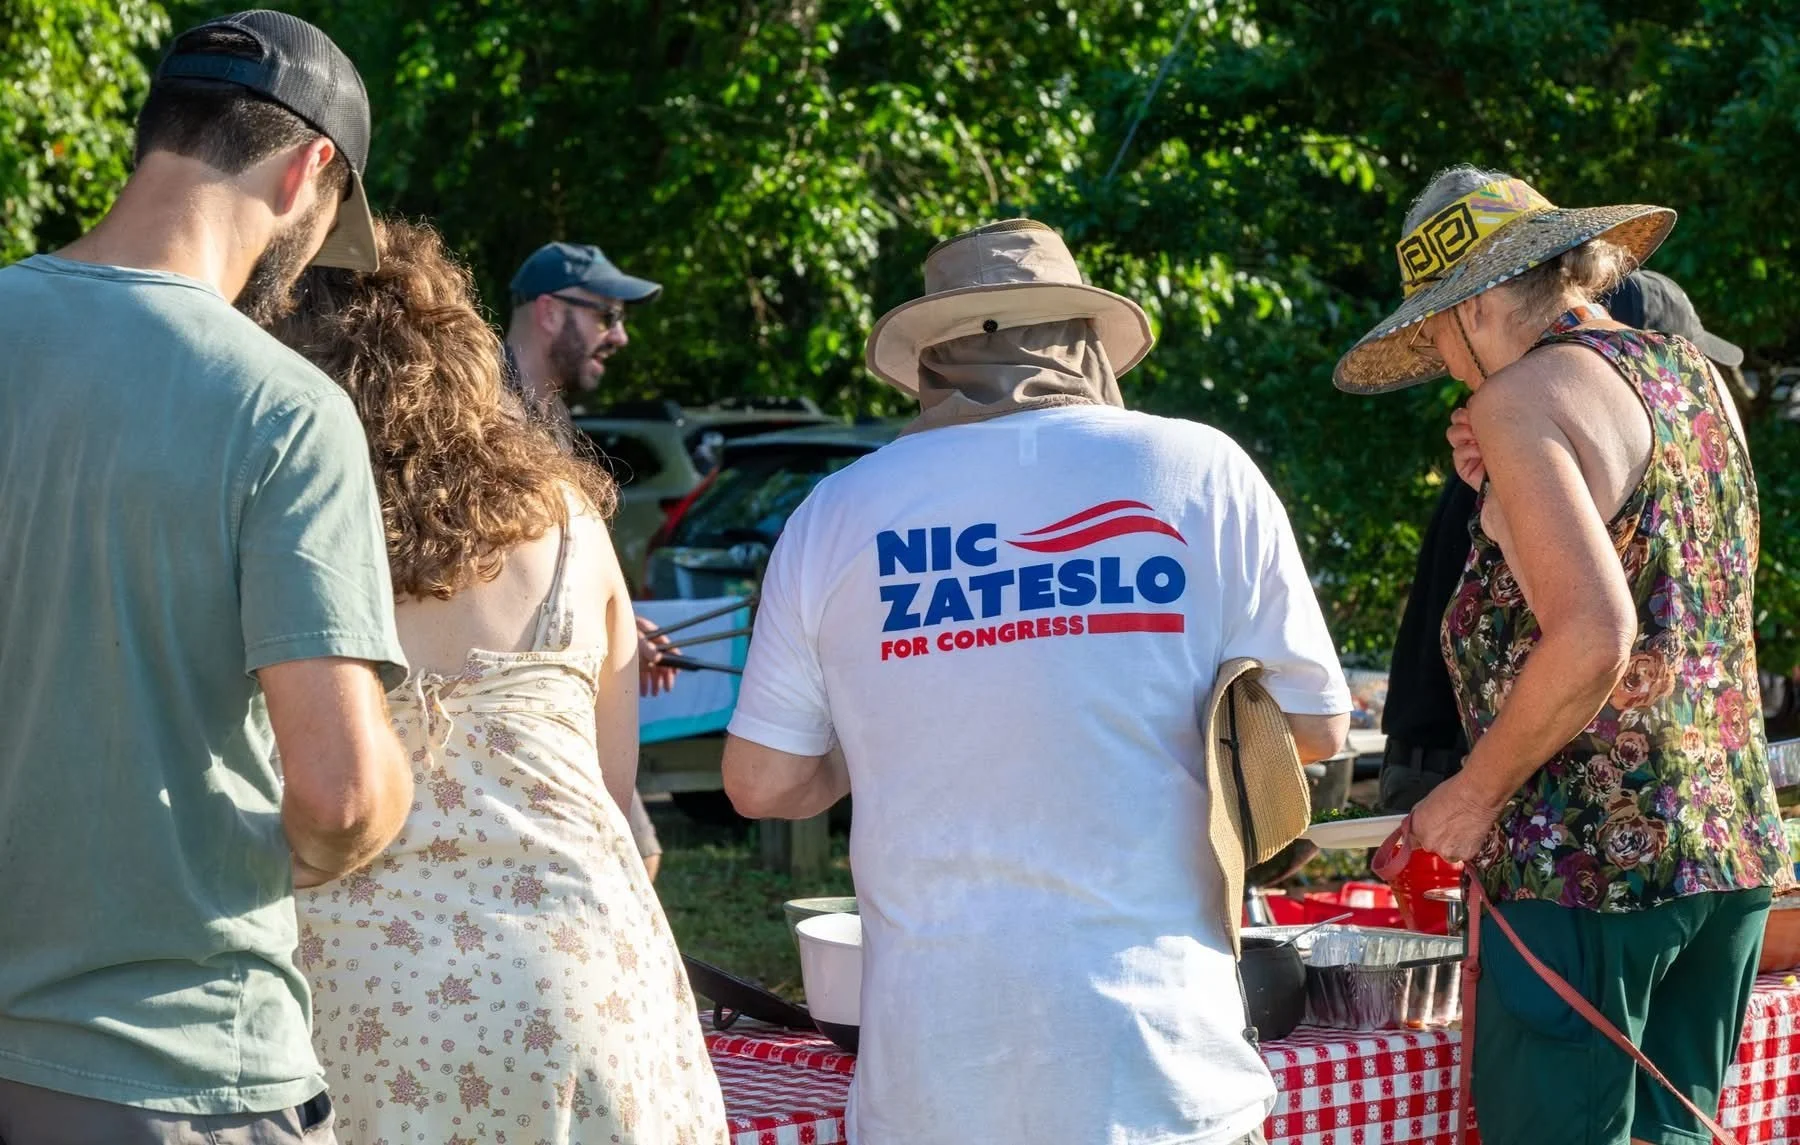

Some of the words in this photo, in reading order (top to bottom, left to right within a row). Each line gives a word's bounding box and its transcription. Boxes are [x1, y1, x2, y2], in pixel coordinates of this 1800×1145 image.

[876, 523, 998, 577] NIC
[879, 555, 1187, 633] ZATESLO
[880, 637, 929, 661] FOR
[936, 615, 1084, 652] CONGRESS
